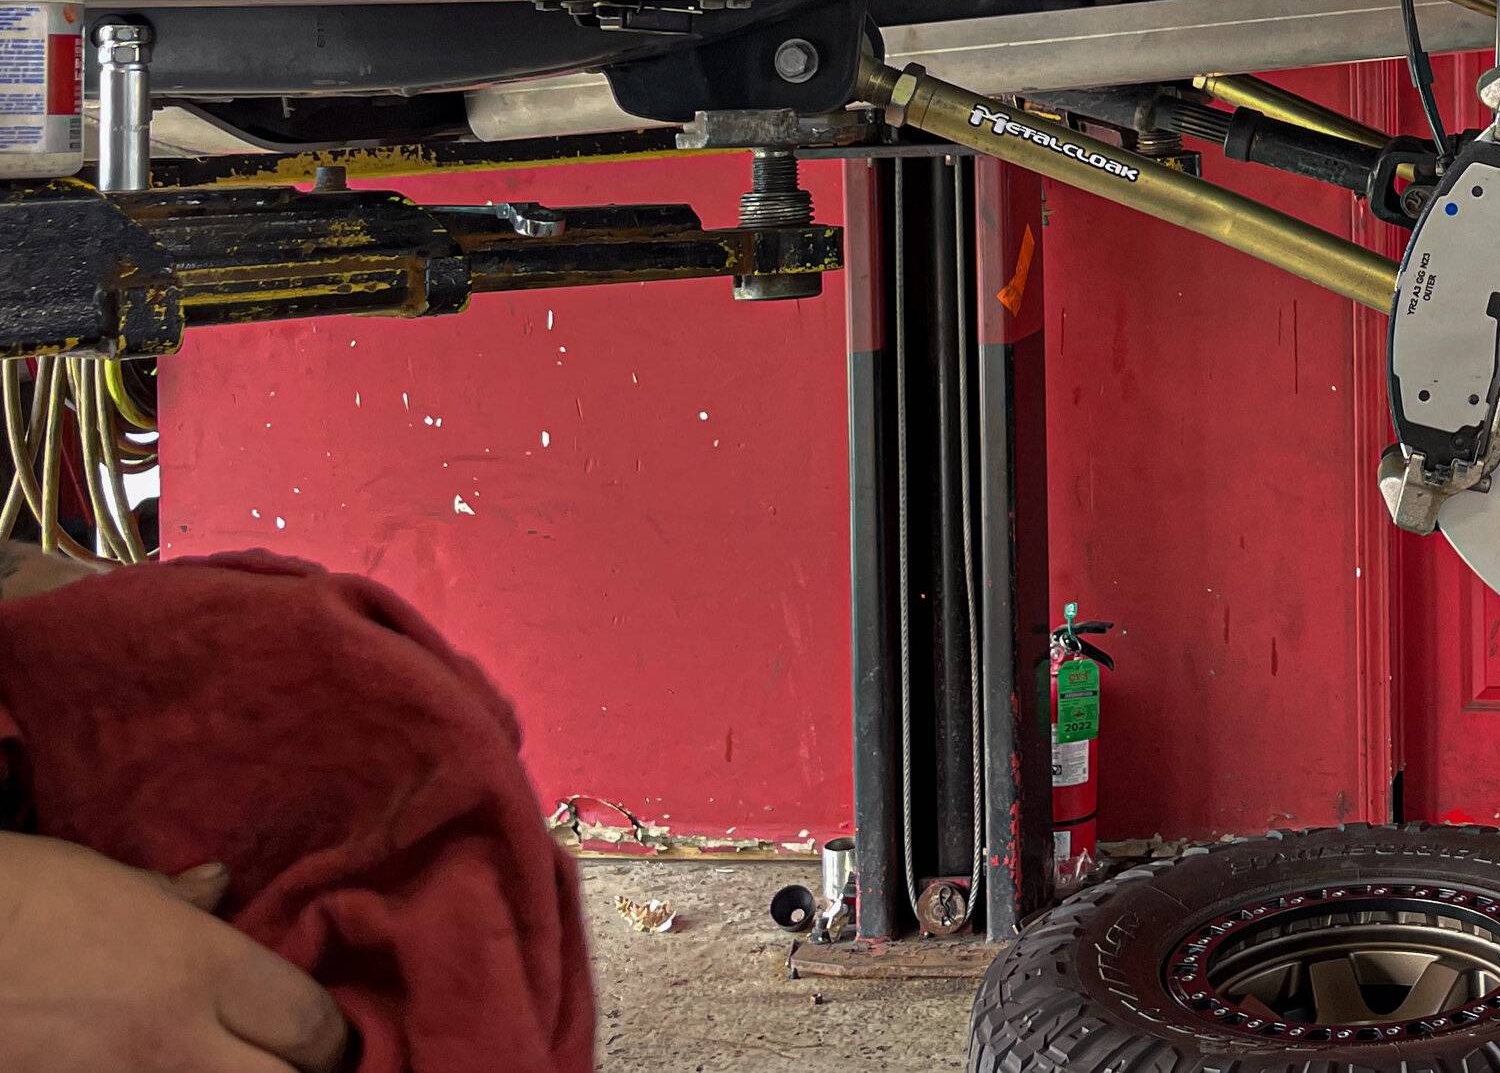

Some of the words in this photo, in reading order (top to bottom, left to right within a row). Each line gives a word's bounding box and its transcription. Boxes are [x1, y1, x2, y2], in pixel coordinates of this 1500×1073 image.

[1416, 270, 1426, 284] GG
[1413, 285, 1422, 298] A3
[1423, 274, 1437, 301] OUTER
[1407, 298, 1419, 315] YR2
[1064, 721, 1092, 732] 2022
